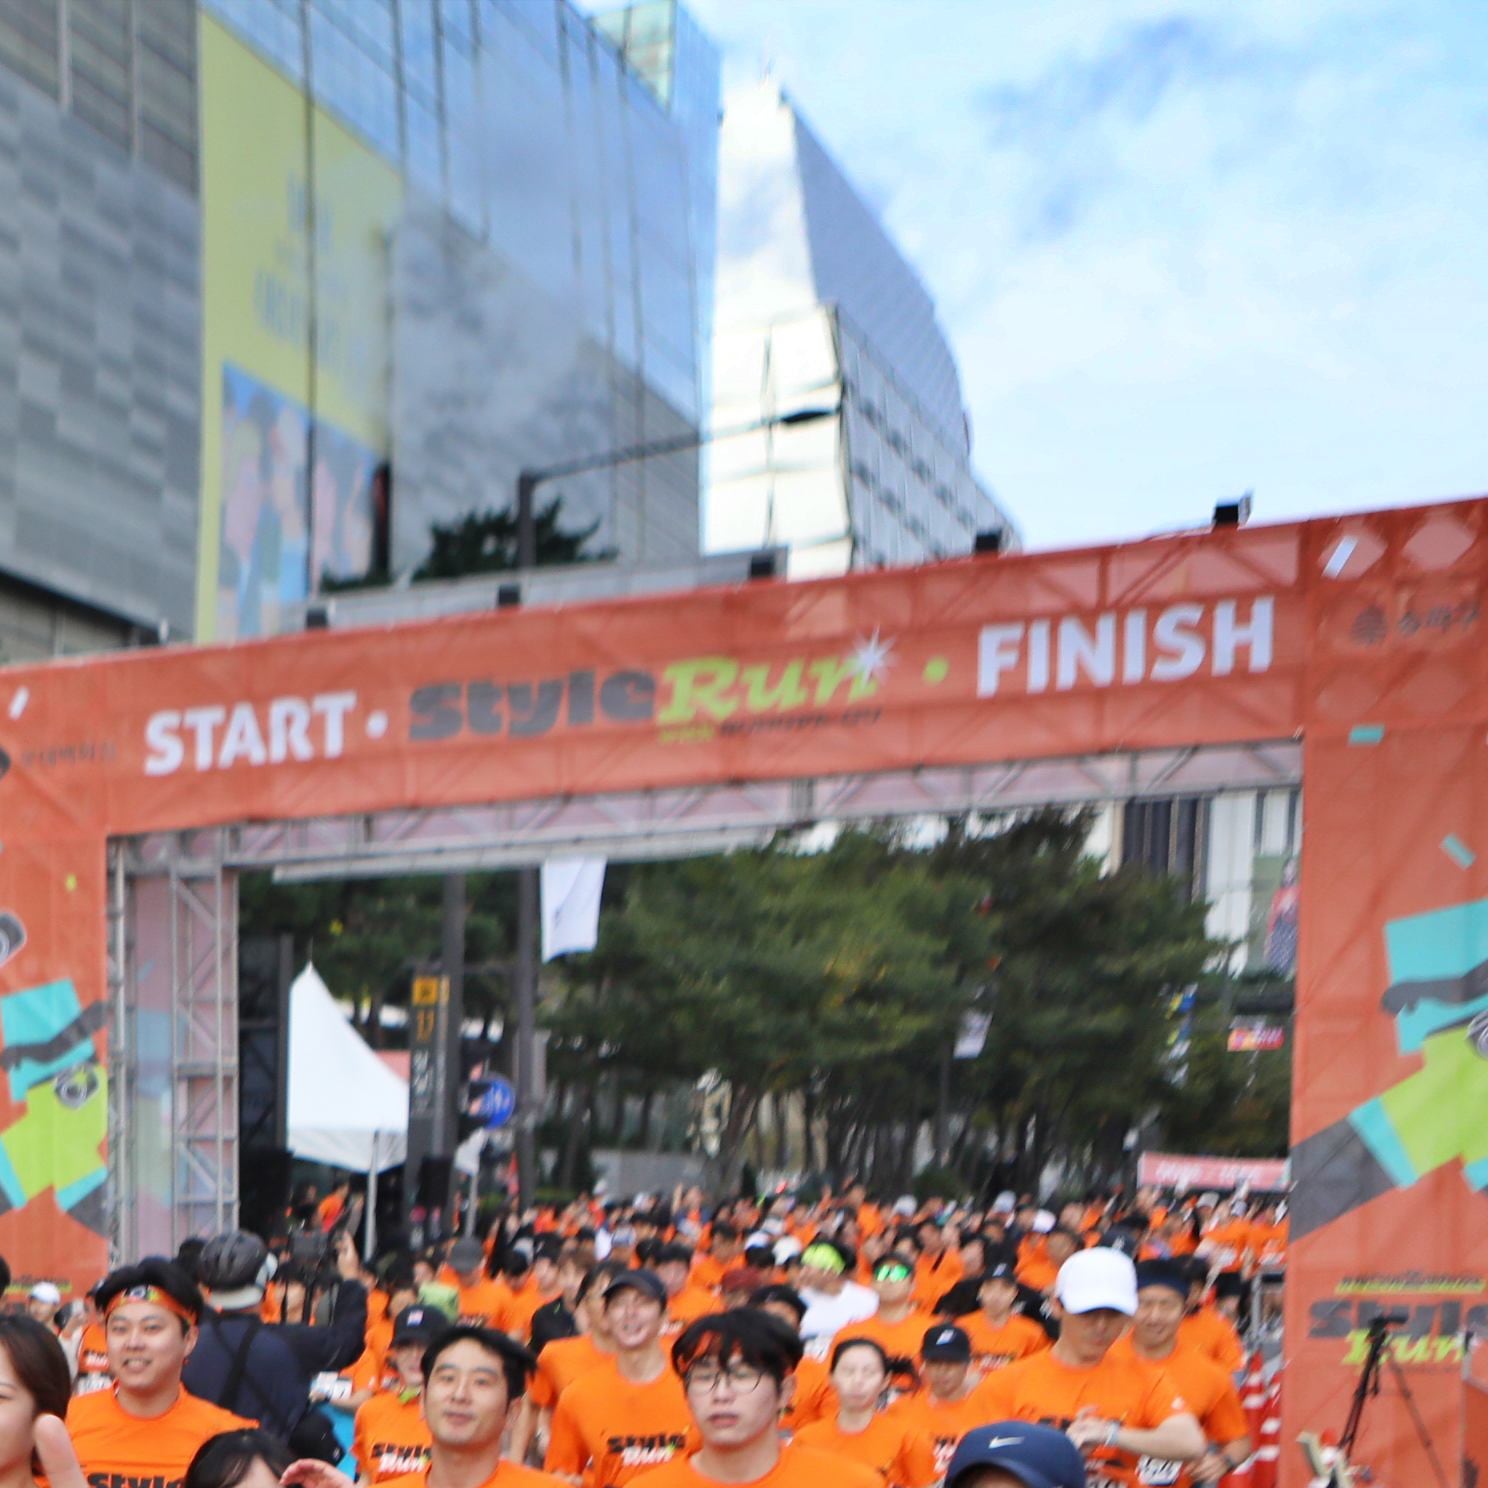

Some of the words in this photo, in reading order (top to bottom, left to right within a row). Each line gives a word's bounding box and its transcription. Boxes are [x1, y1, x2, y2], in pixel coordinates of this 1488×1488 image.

[144, 690, 358, 776] START
[408, 668, 656, 742] Style
[657, 655, 880, 725] Run
[977, 596, 1275, 698] FINISH
